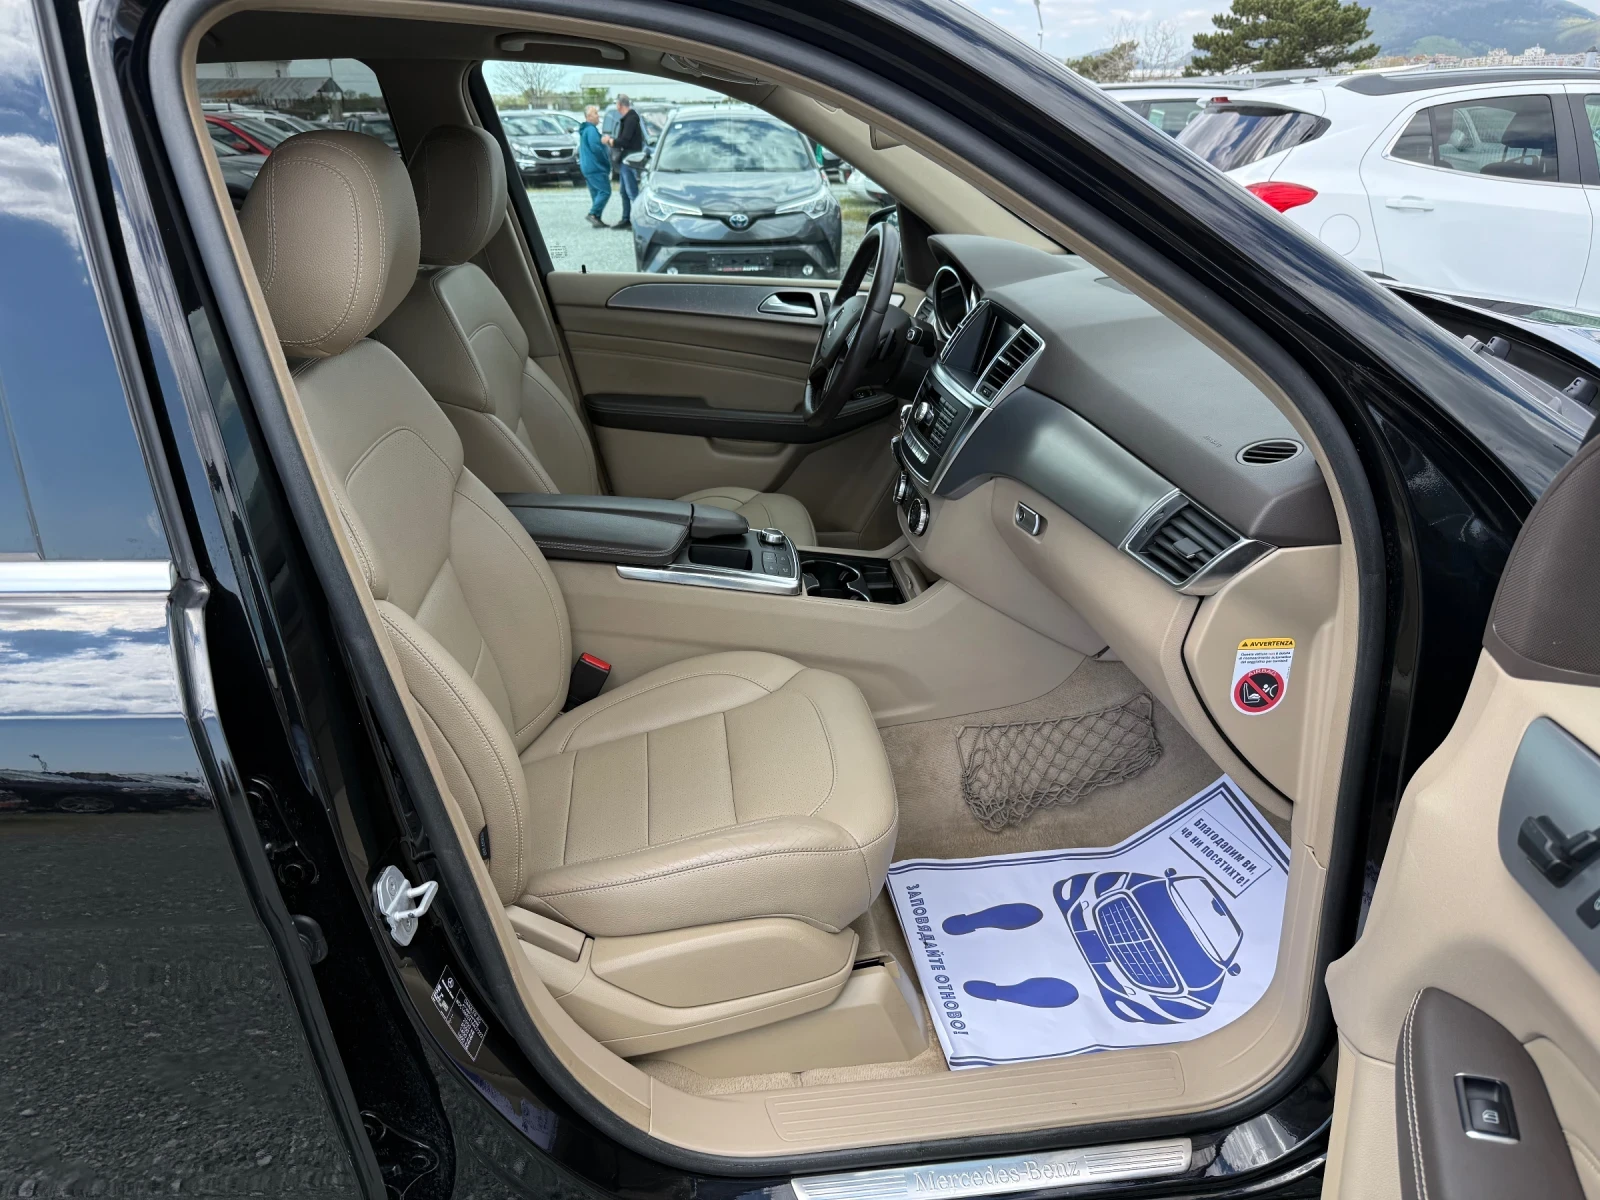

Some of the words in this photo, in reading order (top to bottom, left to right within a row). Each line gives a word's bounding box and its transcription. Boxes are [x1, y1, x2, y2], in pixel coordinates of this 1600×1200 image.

[1248, 668, 1277, 677] AIRBAG
[1181, 827, 1192, 838] че
[1189, 835, 1201, 848] ни
[1200, 845, 1250, 887] посетихте!
[1193, 818, 1245, 863] Благодарим
[1242, 859, 1257, 875] ви,
[906, 883, 946, 971] ЗАПОВЯДАЙТЕ
[934, 974, 969, 1035] ОТНОВО!
[913, 1161, 1080, 1192] Mercedes-Benz
